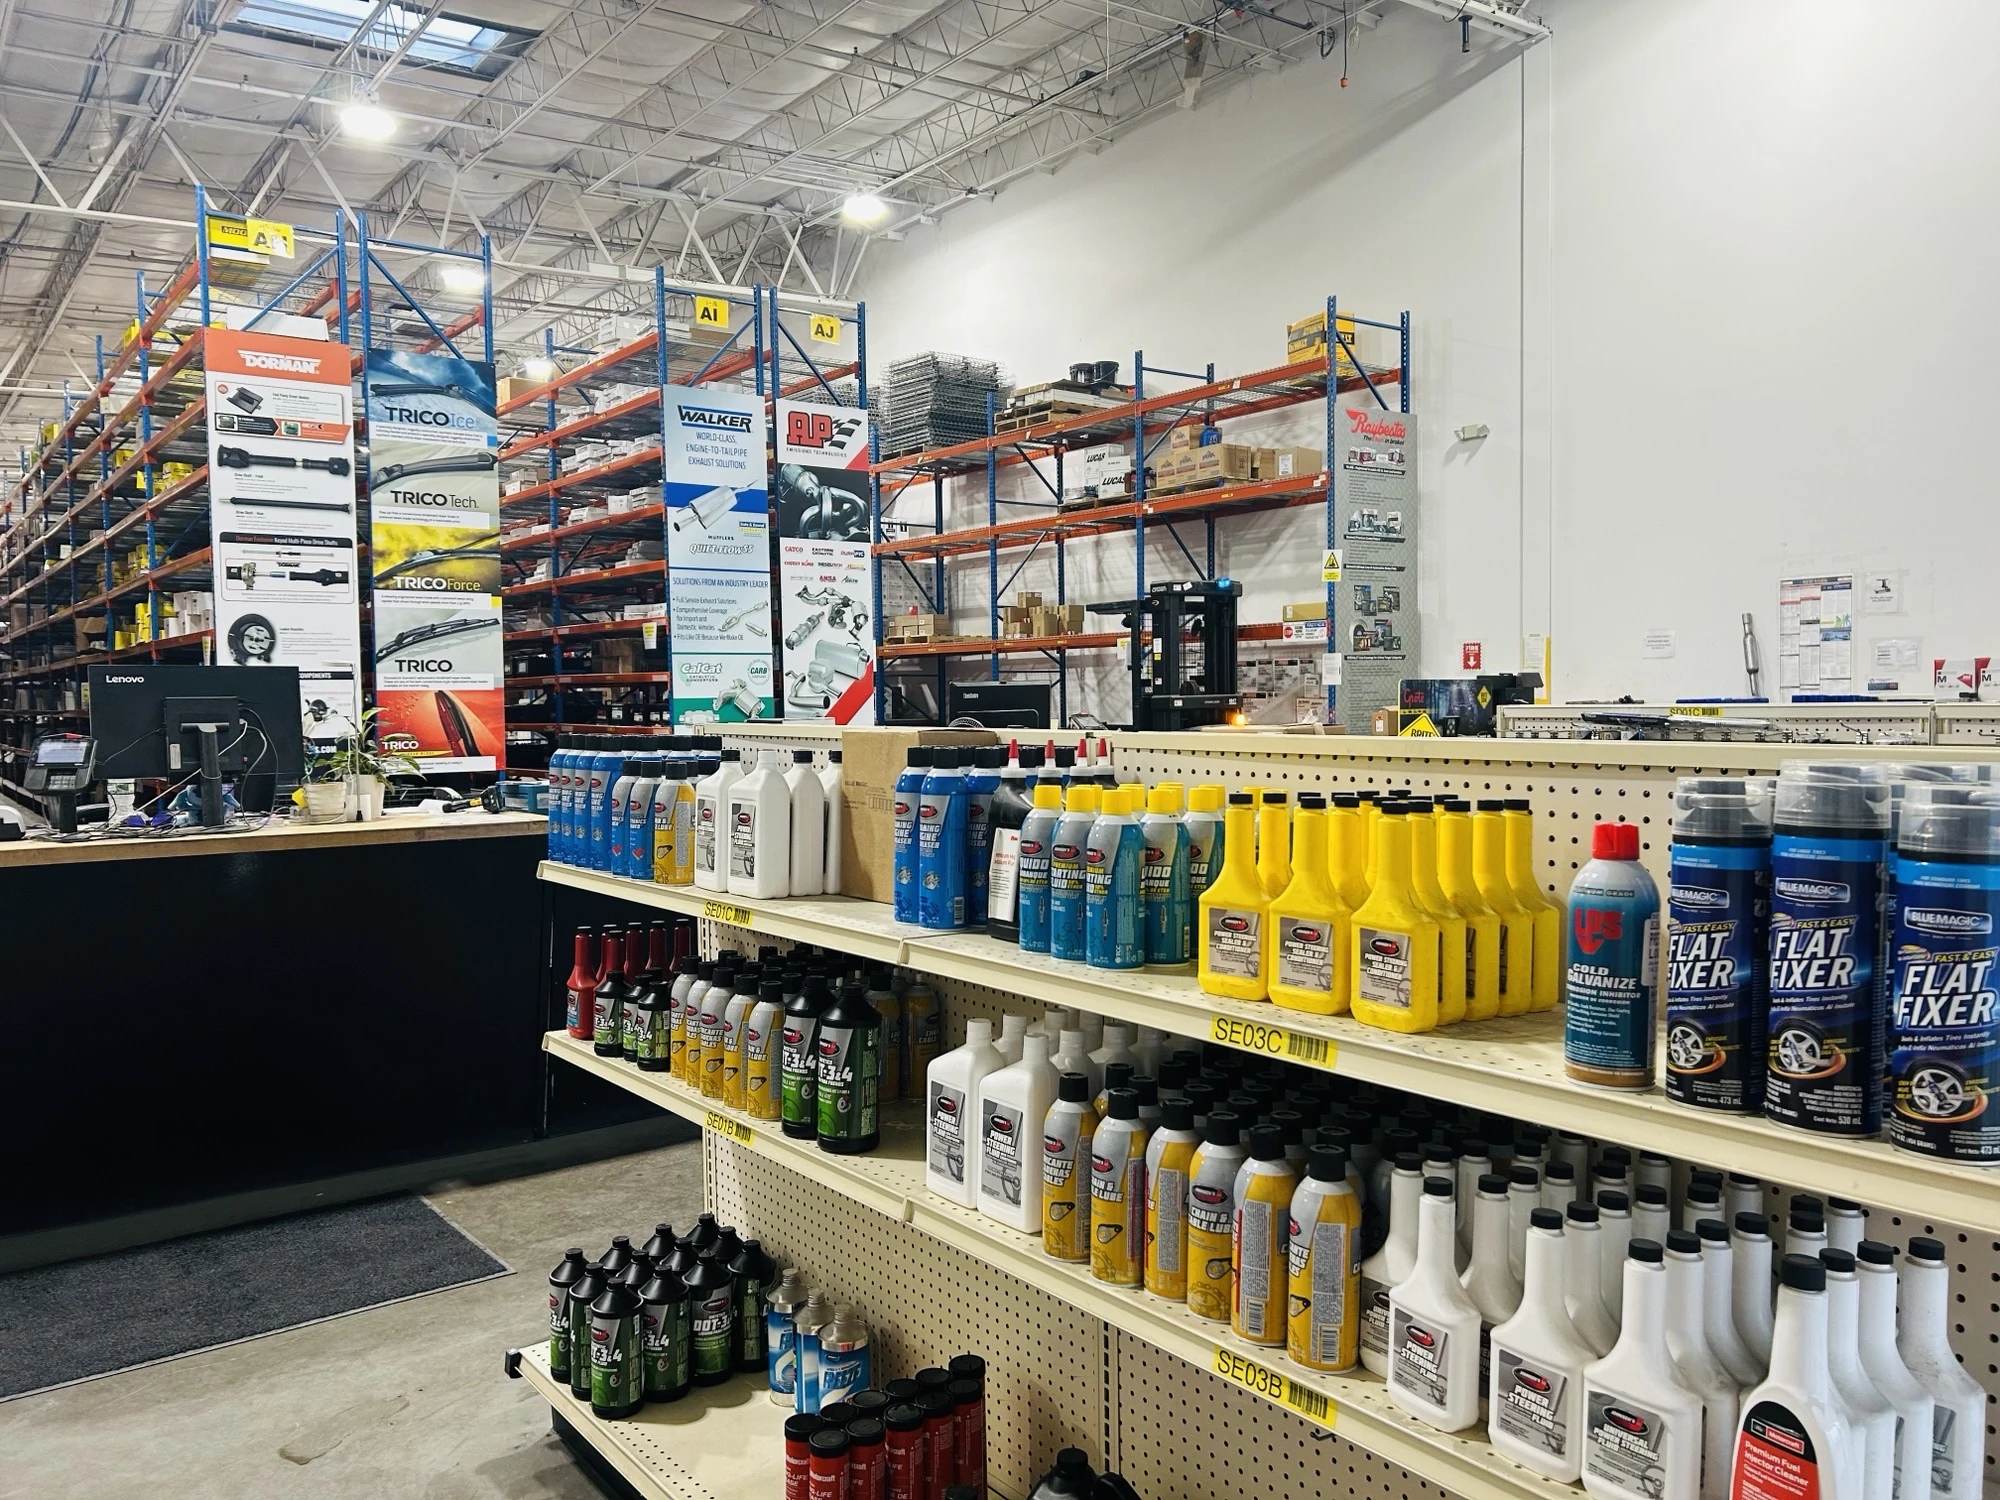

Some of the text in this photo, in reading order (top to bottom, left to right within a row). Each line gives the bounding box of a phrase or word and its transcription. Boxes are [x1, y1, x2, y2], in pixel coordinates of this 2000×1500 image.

[221, 225, 248, 237] MOO
[700, 306, 718, 322] AI
[814, 323, 835, 338] AJ
[244, 354, 320, 374] DORMAN
[385, 406, 449, 426] TRICO
[678, 405, 753, 433] WALKER
[1346, 409, 1406, 438] Raybestos
[786, 411, 833, 448] AP
[686, 443, 748, 457] ENGINE-TO-TAILPIPE
[688, 457, 746, 469] EXHAUST SOLUTIONS
[1102, 476, 1125, 486] LUCAS
[390, 490, 447, 506] TRICO
[393, 576, 447, 590] TRICO
[673, 577, 700, 585] SOLUTIONS
[702, 578, 716, 586] FROM
[750, 580, 768, 588] LEADER
[394, 659, 451, 673] TRICO
[681, 663, 722, 674] CalCat
[106, 675, 144, 683] Lenovo
[382, 740, 419, 750] TRICO
[704, 902, 734, 922] SE01C
[1911, 912, 1981, 927] BLUEMAGIC
[1683, 922, 1735, 932] FAST & EASY
[1797, 918, 1855, 929] FAST & EASY
[1670, 932, 1730, 961] FLAT
[1775, 928, 1850, 960] FLAT
[1934, 950, 1996, 962] FAST & EASY
[1573, 963, 1609, 976] COLD
[1770, 958, 1854, 989] FIXER
[1904, 960, 1992, 995] FLAT
[1567, 968, 1637, 990] GALVANIZE
[1600, 990, 1641, 999] INHIBITOR
[1897, 991, 1995, 1026] FIXER
[1215, 1018, 1283, 1053] SE03C
[706, 1112, 734, 1134] SE01B
[933, 1118, 959, 1135] STEERING
[936, 1111, 957, 1126] POWER
[1838, 1116, 1851, 1124] 530
[990, 1130, 1013, 1144] POWER
[986, 1138, 1016, 1156] STEERING
[1981, 1146, 1992, 1154] 473
[1106, 1181, 1114, 1191] &
[1099, 1189, 1124, 1202] LUBE
[1191, 1206, 1229, 1223] CHAIN &
[1406, 1340, 1434, 1362] POWER
[1400, 1347, 1439, 1373] STEERING
[1217, 1350, 1283, 1399] SE03B
[1420, 1366, 1438, 1382] FLUID
[1514, 1384, 1549, 1406] POWER
[1507, 1392, 1554, 1421] STEERING
[1532, 1413, 1554, 1429] FLUID
[1593, 1427, 1659, 1461] POWER STEERING
[1598, 1436, 1620, 1452] FLUID
[1603, 1423, 1648, 1449] UNIVERSAL
[1769, 1431, 1800, 1449] Motorcraft
[1745, 1440, 1801, 1473] Premium Fuel
[1744, 1450, 1808, 1487] Injector Cleaner
